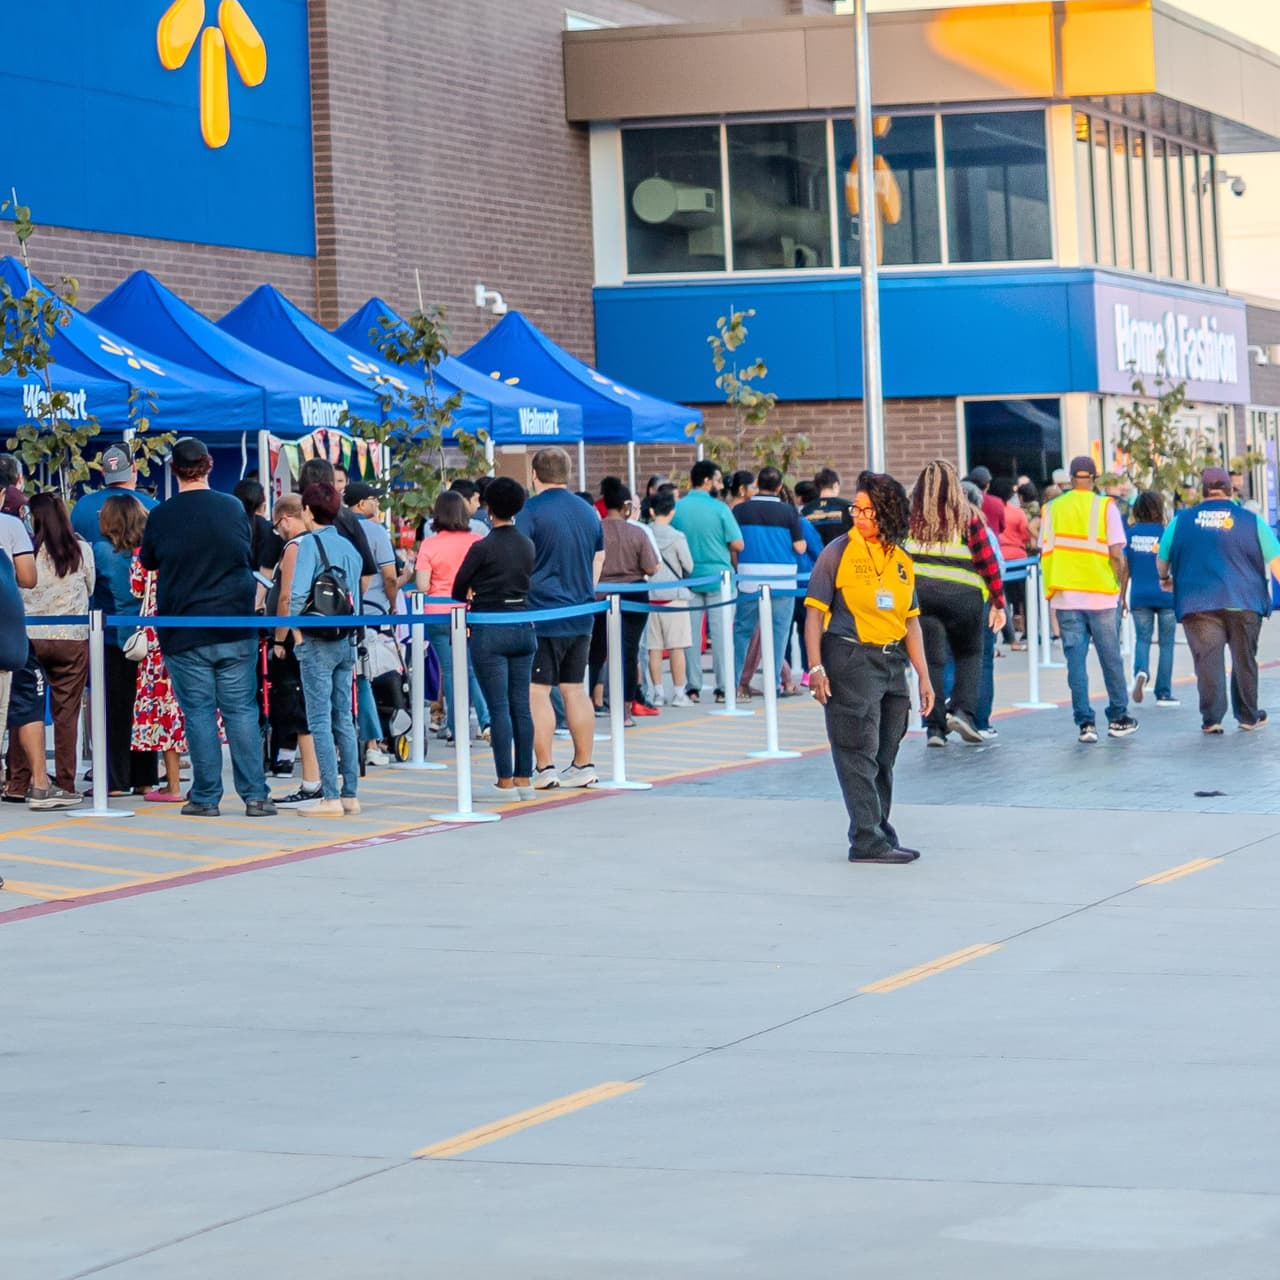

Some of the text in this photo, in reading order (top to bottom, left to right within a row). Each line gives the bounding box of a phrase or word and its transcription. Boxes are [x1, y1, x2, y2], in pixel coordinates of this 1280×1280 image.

[1114, 303, 1167, 378] Home
[1176, 313, 1238, 384] Fashion
[519, 407, 560, 435] Walmart
